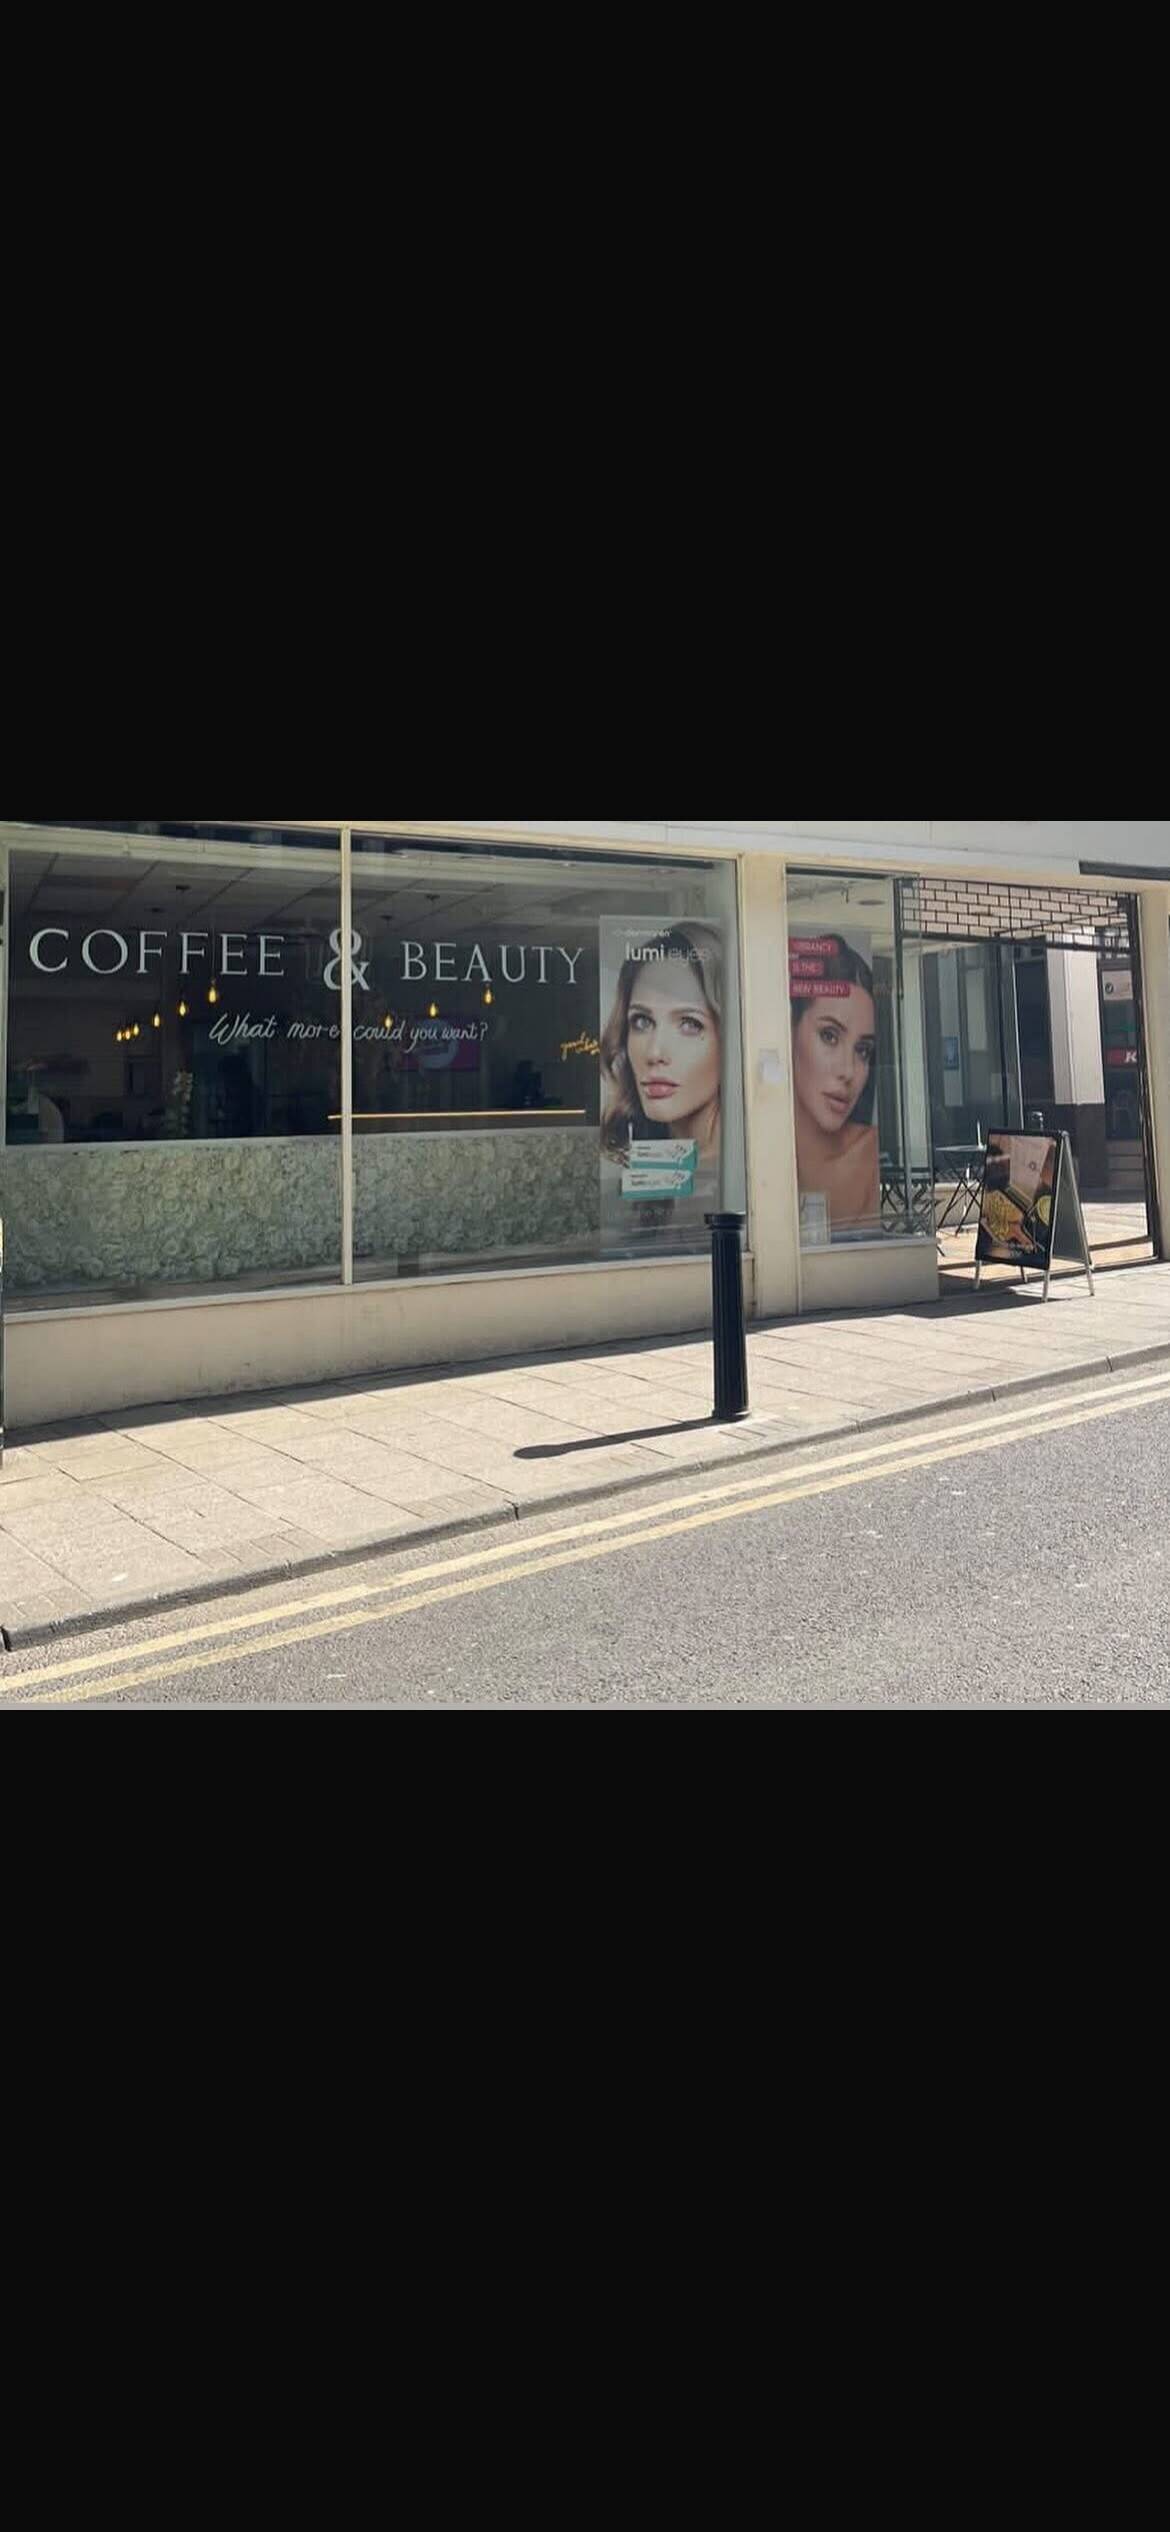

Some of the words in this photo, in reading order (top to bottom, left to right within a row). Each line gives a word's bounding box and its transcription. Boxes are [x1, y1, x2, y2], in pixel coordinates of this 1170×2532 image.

[28, 927, 286, 977] COFFEE
[322, 927, 371, 992] &
[401, 940, 584, 985] BEAUTY
[625, 941, 665, 961] lumi
[208, 1012, 278, 1045] What
[286, 1021, 341, 1041] more
[352, 1019, 404, 1041] could
[403, 1023, 439, 1054] you
[441, 1021, 489, 1042] want?
